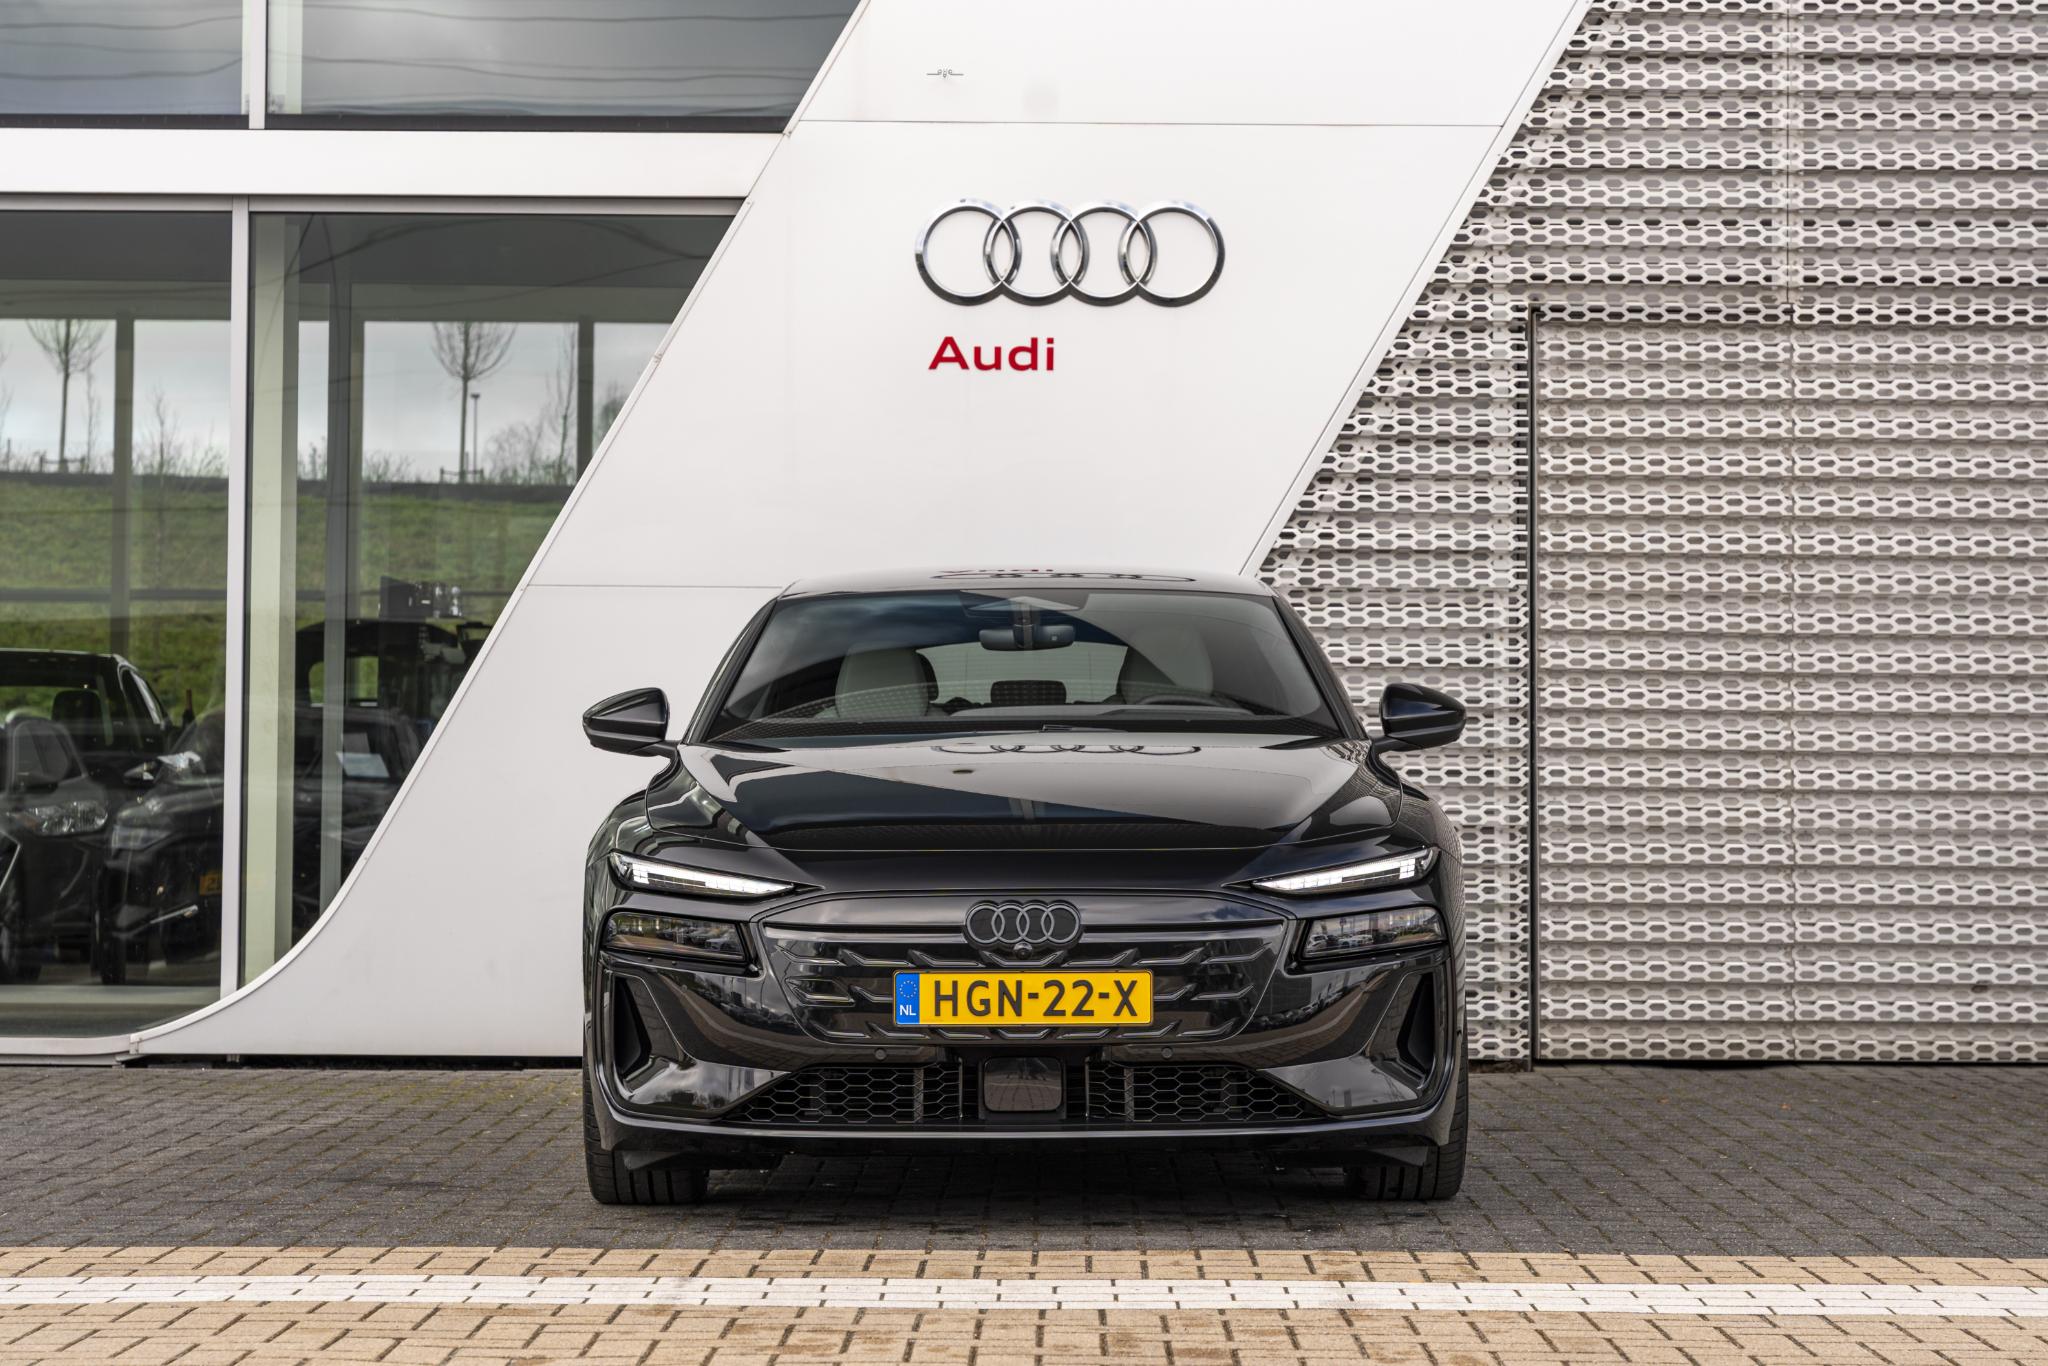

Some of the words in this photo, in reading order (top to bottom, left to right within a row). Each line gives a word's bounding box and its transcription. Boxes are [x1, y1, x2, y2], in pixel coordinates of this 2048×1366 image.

[929, 336, 1055, 372] Audi
[899, 1004, 917, 1016] NL
[934, 979, 1138, 1017] HGN-22-X
